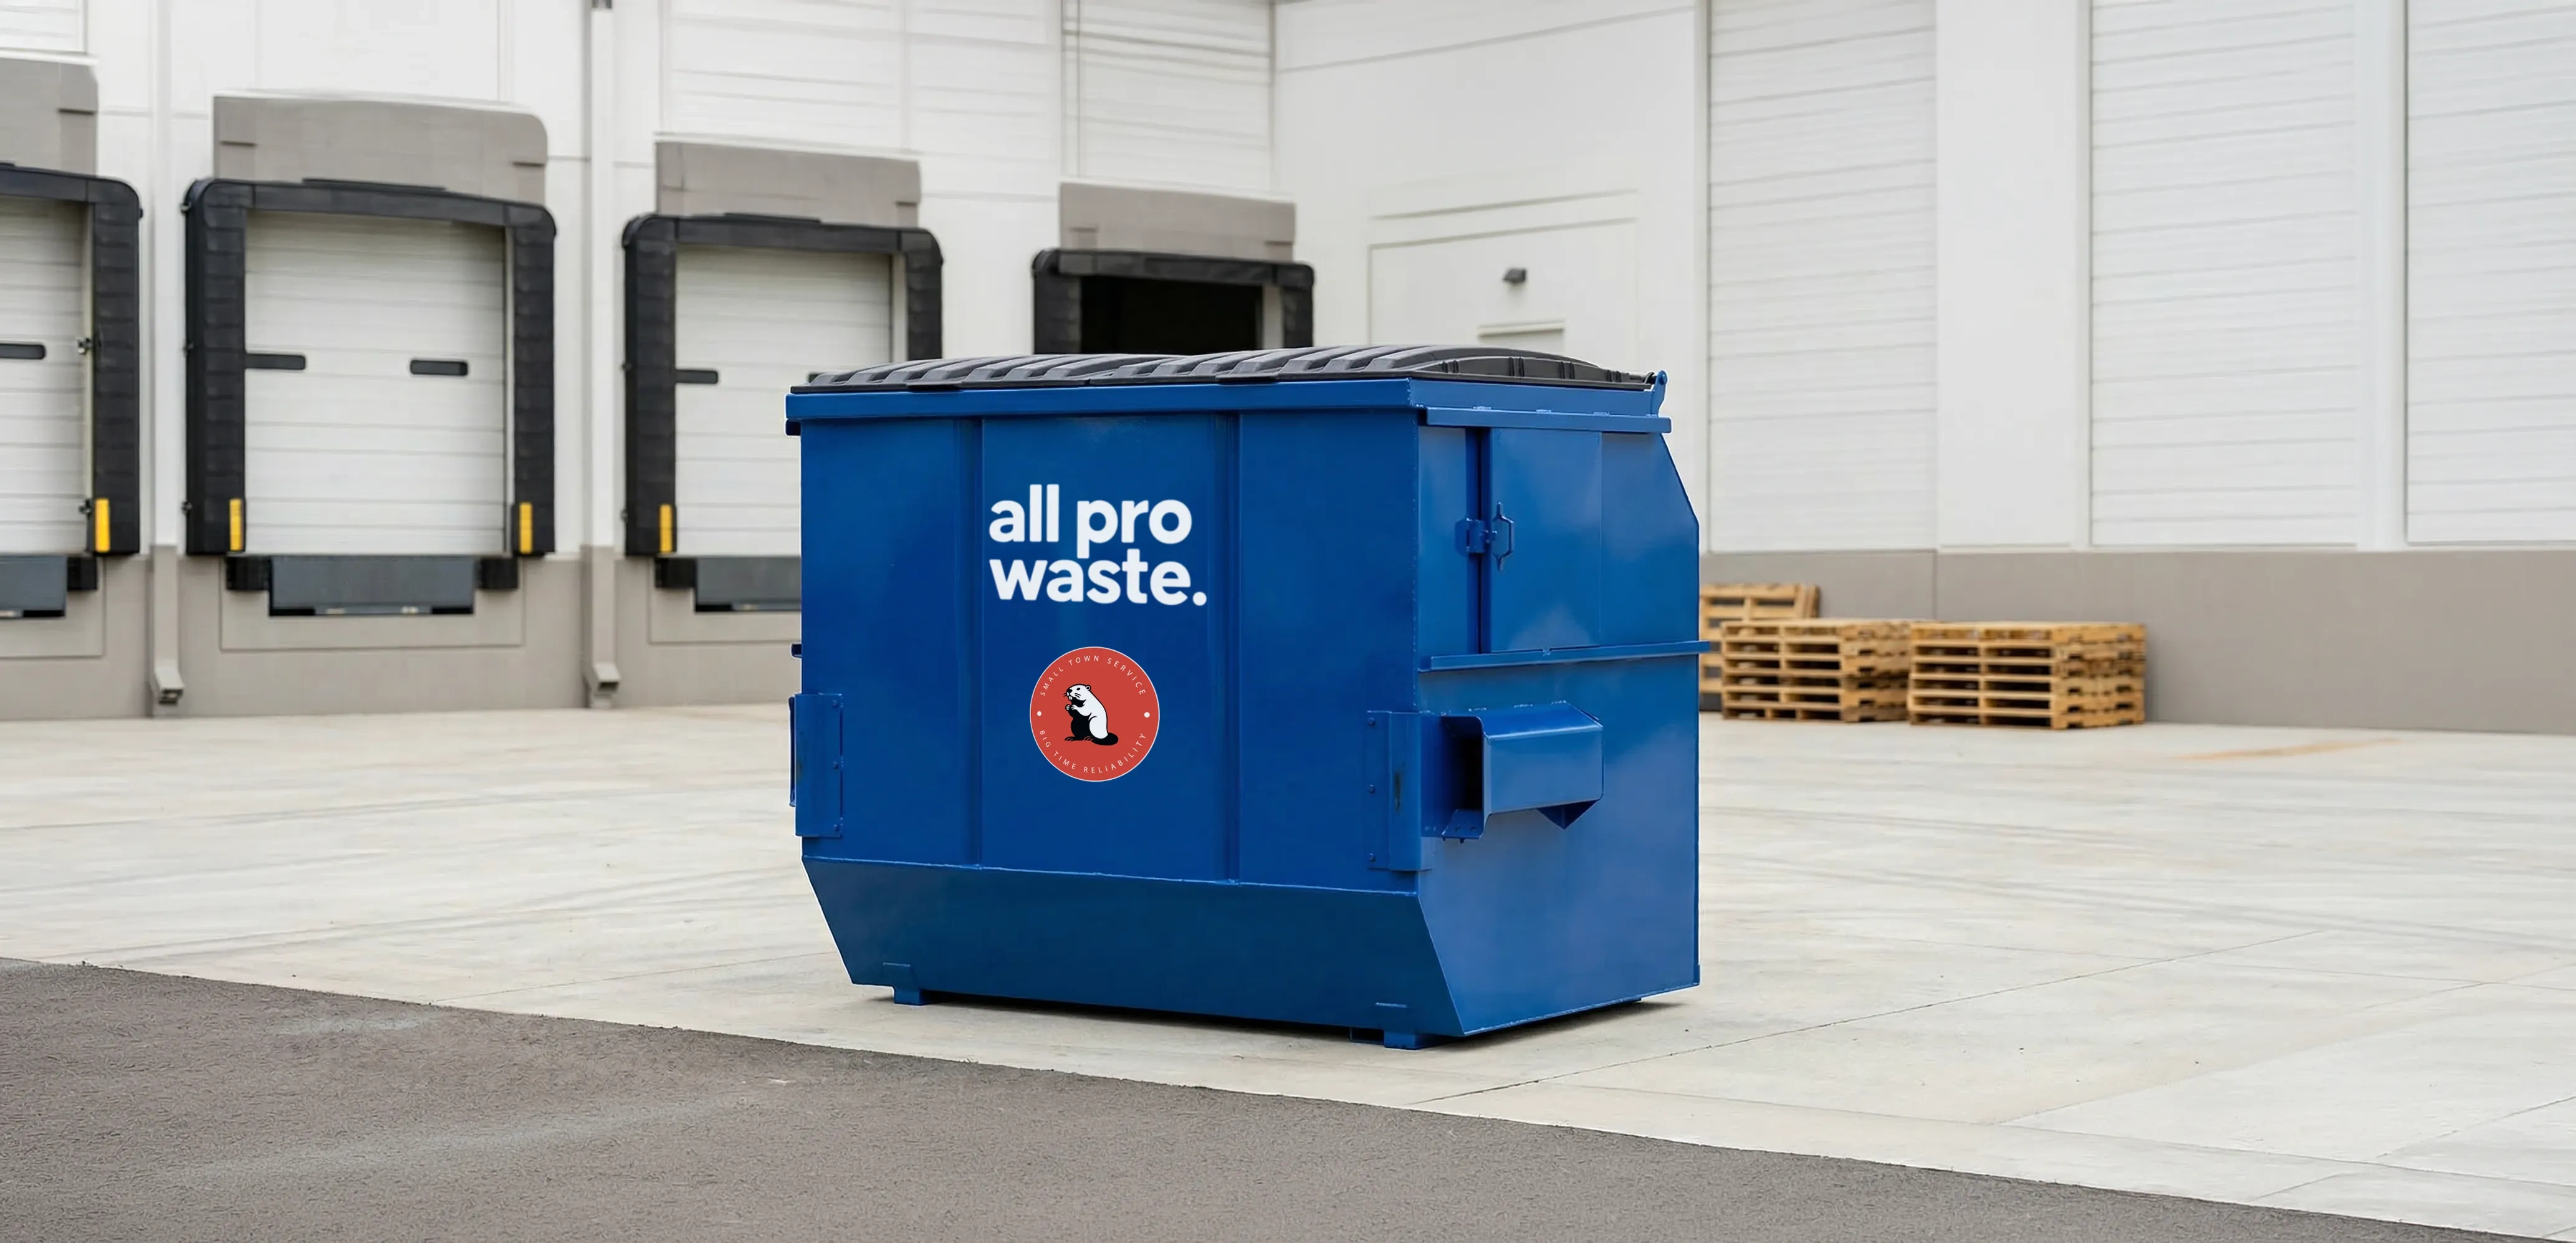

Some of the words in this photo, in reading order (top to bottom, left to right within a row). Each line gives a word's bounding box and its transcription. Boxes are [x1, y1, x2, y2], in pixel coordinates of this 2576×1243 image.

[989, 484, 1060, 542] all
[1076, 499, 1192, 559] pro
[989, 549, 1207, 606] waste.
[1040, 667, 1064, 696] SMALL
[1068, 655, 1099, 666] TOWN
[1107, 658, 1146, 695] SERVICE
[1040, 730, 1051, 747] BIG
[1053, 751, 1076, 770] TIME
[1083, 733, 1146, 774] RELIABILITY
